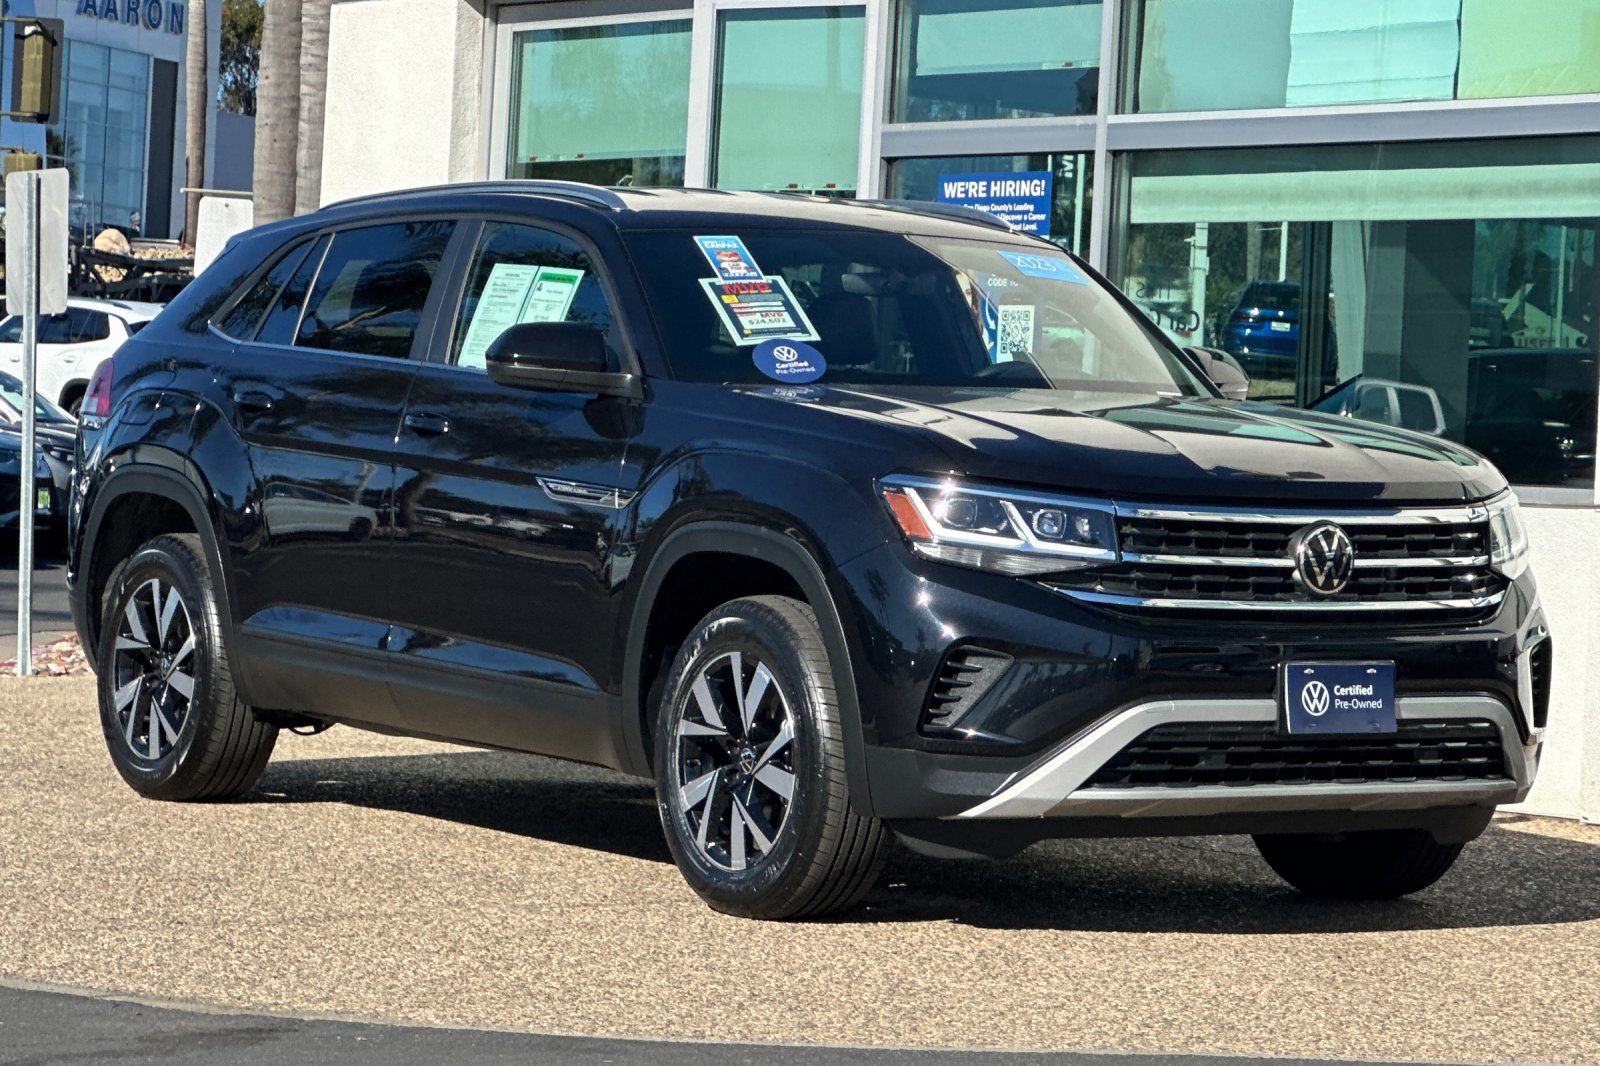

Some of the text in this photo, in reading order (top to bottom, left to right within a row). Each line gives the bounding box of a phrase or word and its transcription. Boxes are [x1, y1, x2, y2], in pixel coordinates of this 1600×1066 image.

[82, 0, 184, 34] AARON
[943, 179, 1046, 199] WE'RE HIRING!
[990, 203, 1013, 212] County's
[1013, 202, 1035, 212] Leading
[1028, 213, 1046, 221] Career
[987, 278, 1008, 287] CODE
[775, 361, 810, 369] Certified
[775, 366, 816, 375] Pre-Owned
[1333, 684, 1374, 696] Certified
[1334, 698, 1383, 710] Pre-Owned
